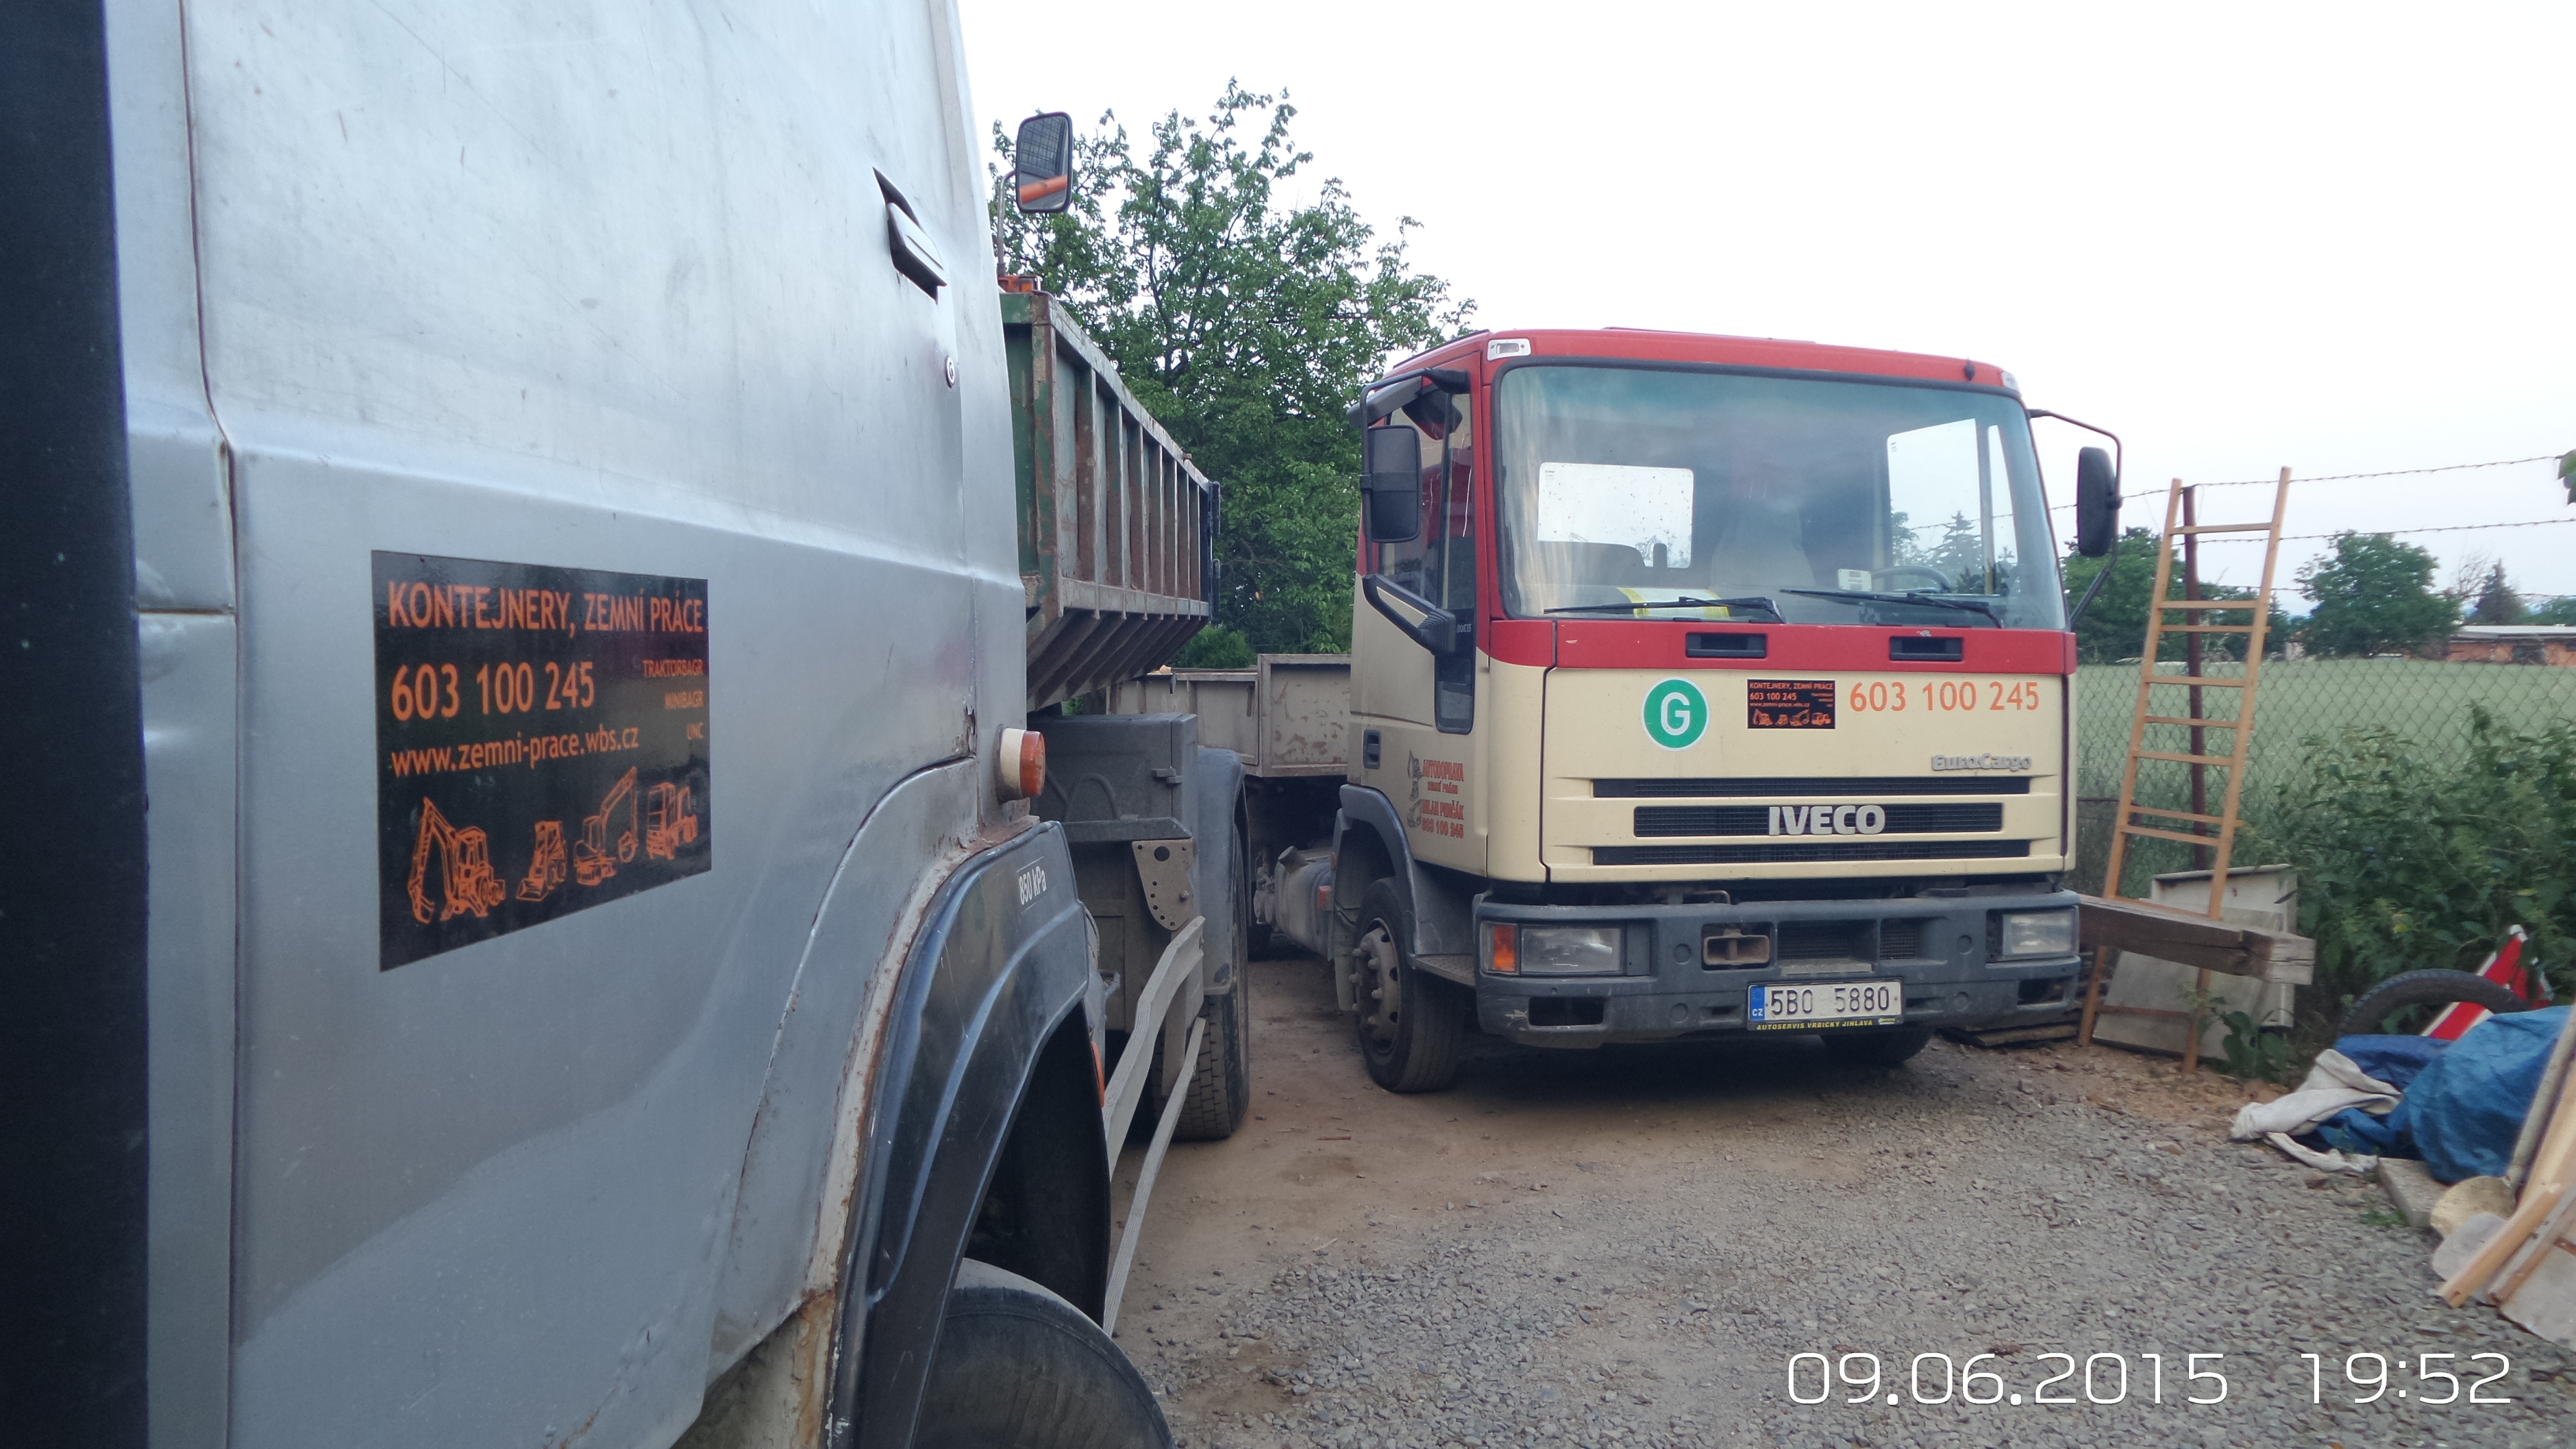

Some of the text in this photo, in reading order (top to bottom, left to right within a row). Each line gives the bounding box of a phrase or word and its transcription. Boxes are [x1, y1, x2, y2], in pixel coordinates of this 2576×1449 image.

[389, 581, 703, 639] KONTEJNERY, ZEMNÍ PRÁCE
[642, 659, 703, 677] TRAKTORBAGR
[391, 661, 596, 721] 603 100 245
[665, 690, 703, 709] MINIBAGR
[1850, 681, 2039, 711] 603 100 245
[1661, 692, 1690, 735] G
[392, 723, 639, 777] www.zemni-prace.wbs.cz
[1931, 752, 2032, 771] EuroCargo
[1423, 759, 1464, 781] AUTODOPRAVA
[1435, 820, 1448, 836] 100
[1450, 822, 1464, 838] 245
[1768, 805, 1886, 836] IVECO
[1019, 866, 1047, 905] 850 kPa
[1752, 1009, 1763, 1017] CZ
[1834, 986, 1889, 1012] 5880
